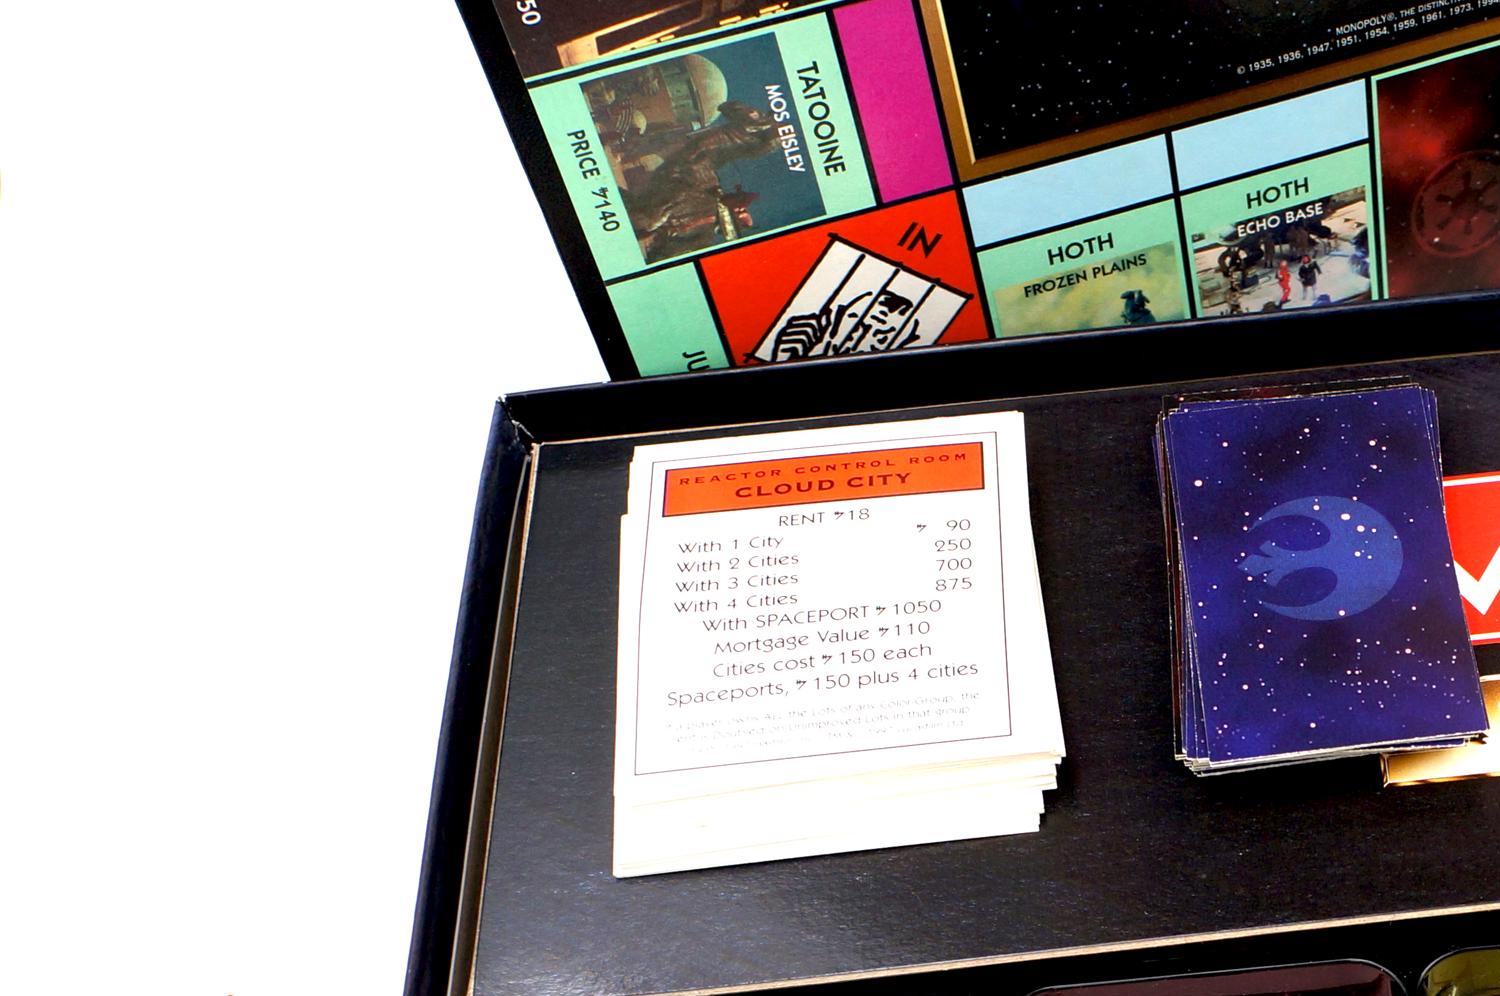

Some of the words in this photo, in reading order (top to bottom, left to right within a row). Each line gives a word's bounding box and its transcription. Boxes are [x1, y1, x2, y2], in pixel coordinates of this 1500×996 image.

[1400, 7, 1415, 18] THE
[765, 83, 790, 123] MOS
[796, 60, 846, 177] TATOOINE
[567, 129, 600, 180] PRICE
[777, 125, 806, 173] EISLEY
[1246, 176, 1309, 209] HOTH
[1237, 215, 1281, 237] ECHO
[1285, 202, 1324, 224] BASE
[897, 222, 943, 258] IN
[1047, 232, 1114, 265] HOTH
[1024, 270, 1087, 298] FROZEN
[1093, 253, 1147, 279] PLAINS
[679, 468, 783, 485] REACTOR
[795, 459, 896, 474] CONTROL
[909, 452, 968, 464] ROOM
[735, 478, 835, 498] CLOUD
[846, 472, 912, 489] CITY
[778, 511, 826, 527] RENT
[678, 540, 722, 555] With
[749, 536, 785, 551] City
[934, 538, 972, 552] 250
[676, 560, 721, 574] With
[728, 557, 741, 570] 2
[748, 553, 799, 569] Cities
[935, 557, 972, 572] 700
[675, 579, 719, 593] With
[727, 576, 739, 590] 3
[747, 573, 799, 589] Cities
[935, 577, 973, 592] 875
[673, 599, 718, 613] With
[726, 597, 738, 610] 4
[746, 593, 798, 608] Cities
[702, 617, 747, 633] With
[756, 605, 870, 629] SPACEPORT
[714, 634, 809, 656] Mortgage
[817, 627, 870, 644] Value
[713, 661, 766, 678] Cities
[773, 654, 816, 671] cost
[884, 642, 932, 660] each
[667, 682, 790, 708] Spaceports,
[858, 669, 900, 689] plus
[907, 668, 918, 681] 4
[927, 661, 979, 680] cities
